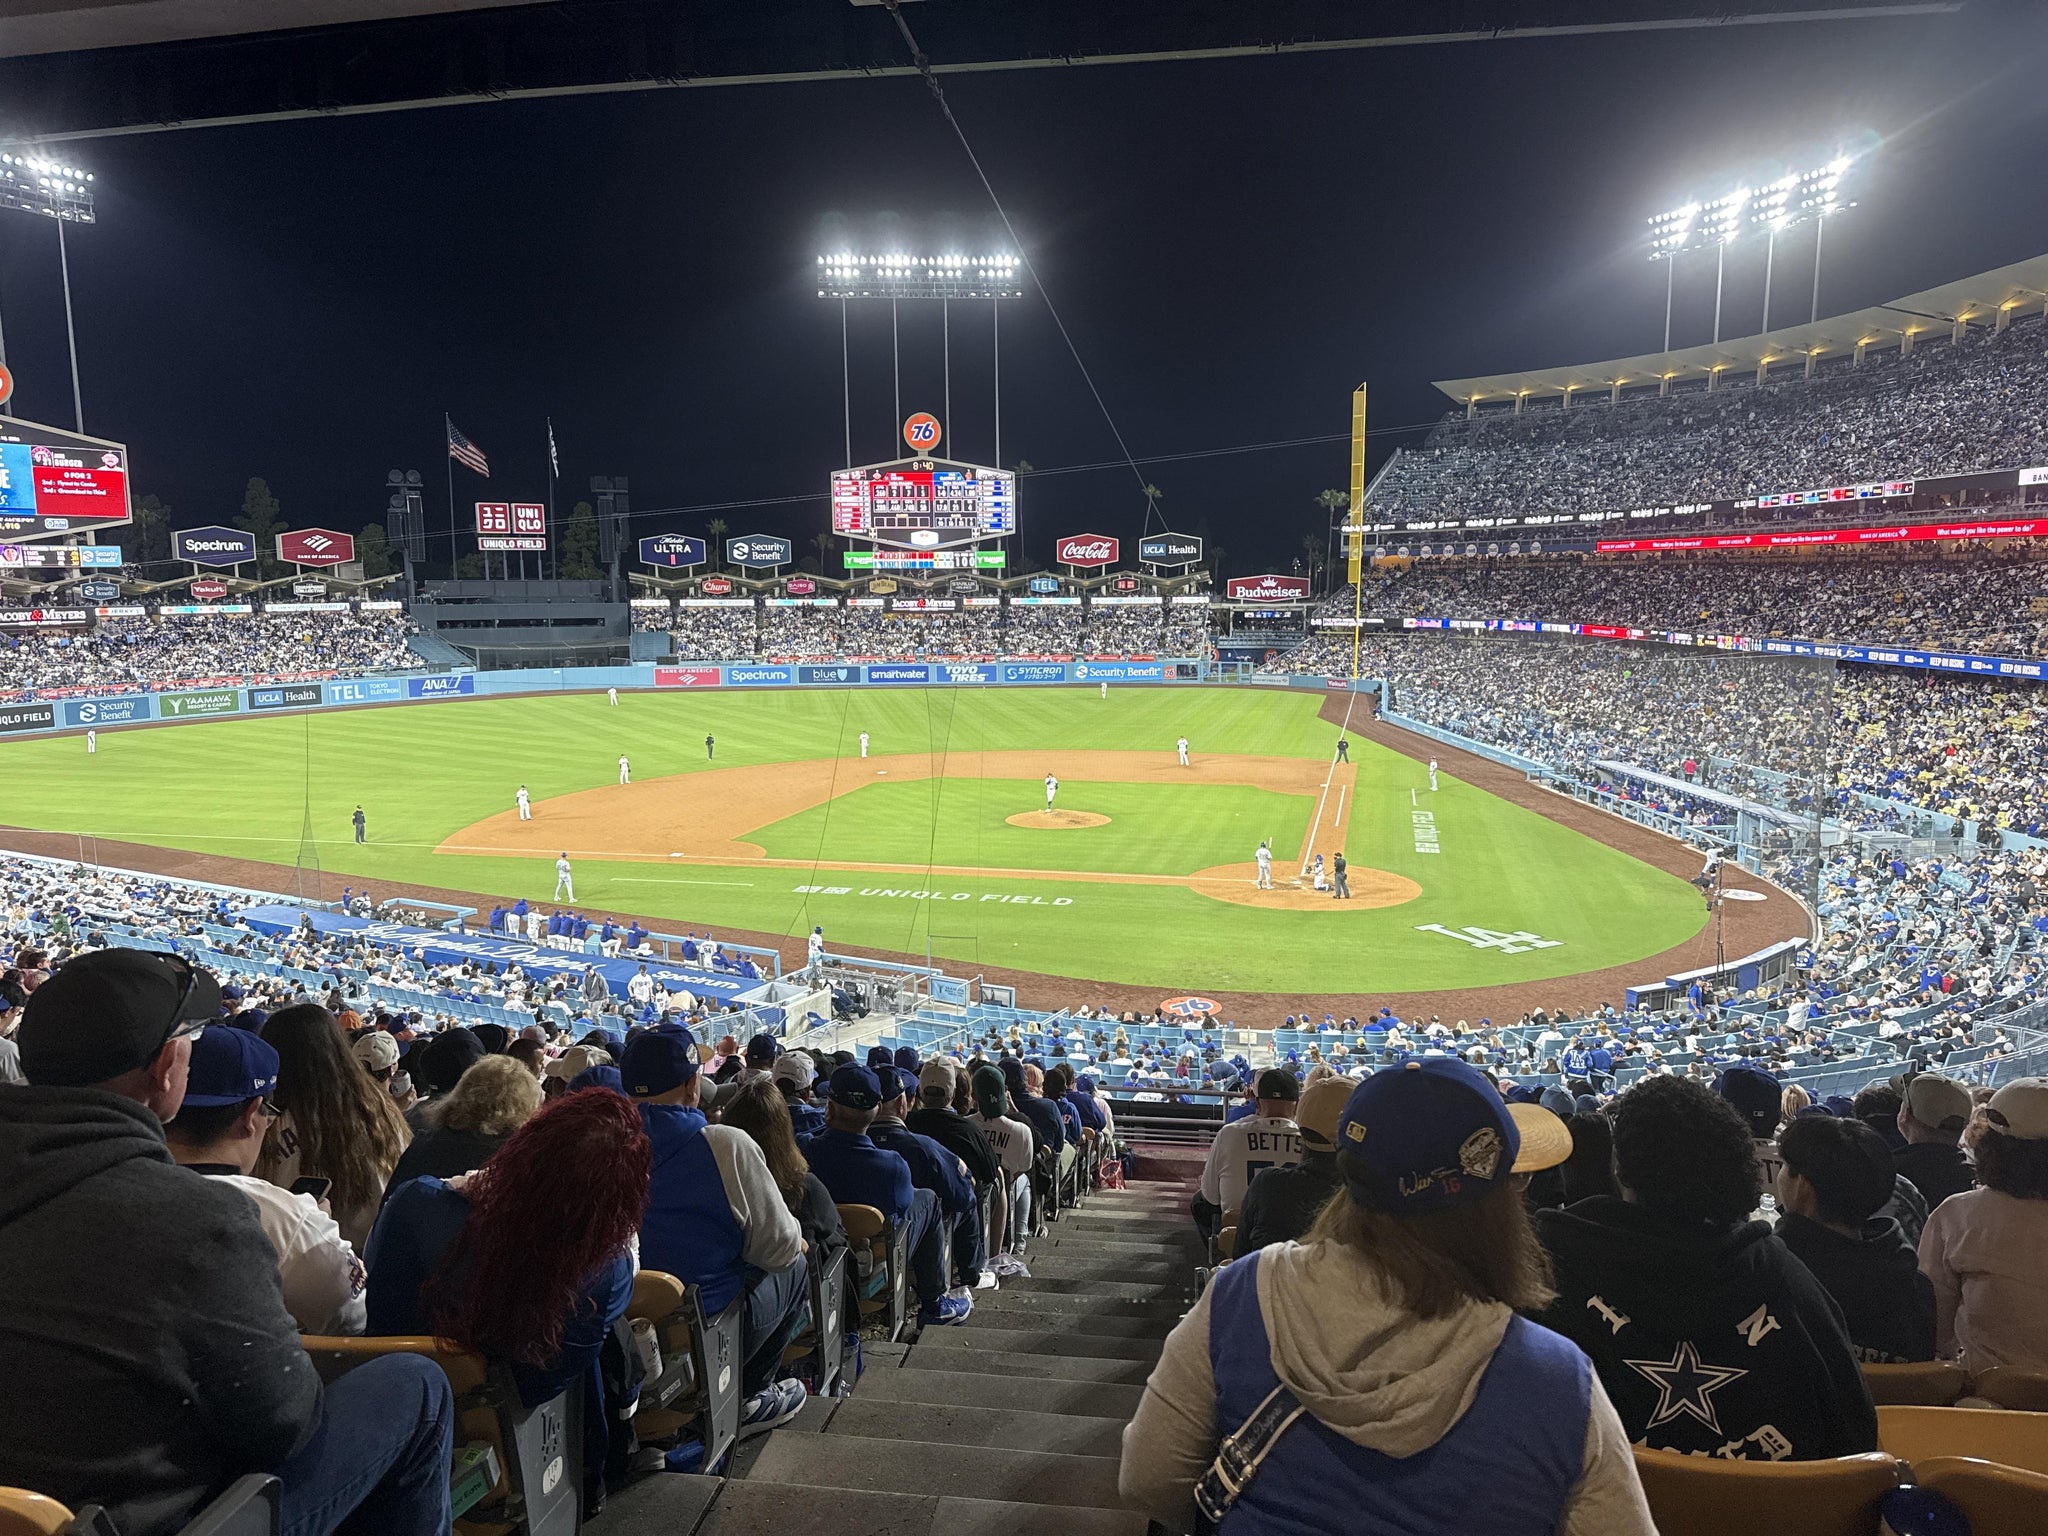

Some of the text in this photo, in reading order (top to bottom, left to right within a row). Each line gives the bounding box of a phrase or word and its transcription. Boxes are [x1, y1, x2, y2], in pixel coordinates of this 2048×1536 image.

[912, 422, 934, 441] 76
[912, 462, 934, 470] 8:40
[483, 508, 504, 517] ユニ
[518, 508, 538, 518] UNI
[519, 520, 541, 531] QLO
[186, 539, 243, 553] Spectrum
[484, 540, 542, 549] UNIQLO FIELD
[654, 544, 691, 553] ULTRA
[752, 543, 785, 552] Security
[1144, 546, 1197, 554] UCLA Health
[1063, 542, 1112, 559] Coca-Cola
[704, 582, 730, 591] Churu
[1034, 581, 1054, 590] TEL
[1236, 586, 1301, 598] Budweiser
[731, 670, 782, 682] Spectrum
[813, 668, 837, 679] blue
[871, 670, 926, 679] smartwater
[946, 666, 978, 675] TOYO
[1090, 668, 1158, 679] Security Benefit
[952, 674, 985, 682] TIRES
[422, 679, 448, 690] ANA
[258, 691, 316, 703] UCLA Health
[331, 685, 364, 700] TEL
[99, 701, 135, 711] Security
[23, 711, 51, 722] FIELD
[101, 710, 131, 720] Benefit
[859, 888, 970, 900] UNIQLO
[980, 894, 1073, 906] FIELD
[1414, 924, 1565, 954] LA
[652, 970, 740, 989] Spectrum
[1172, 998, 1212, 1014] 76
[1248, 1132, 1302, 1153] BETTS
